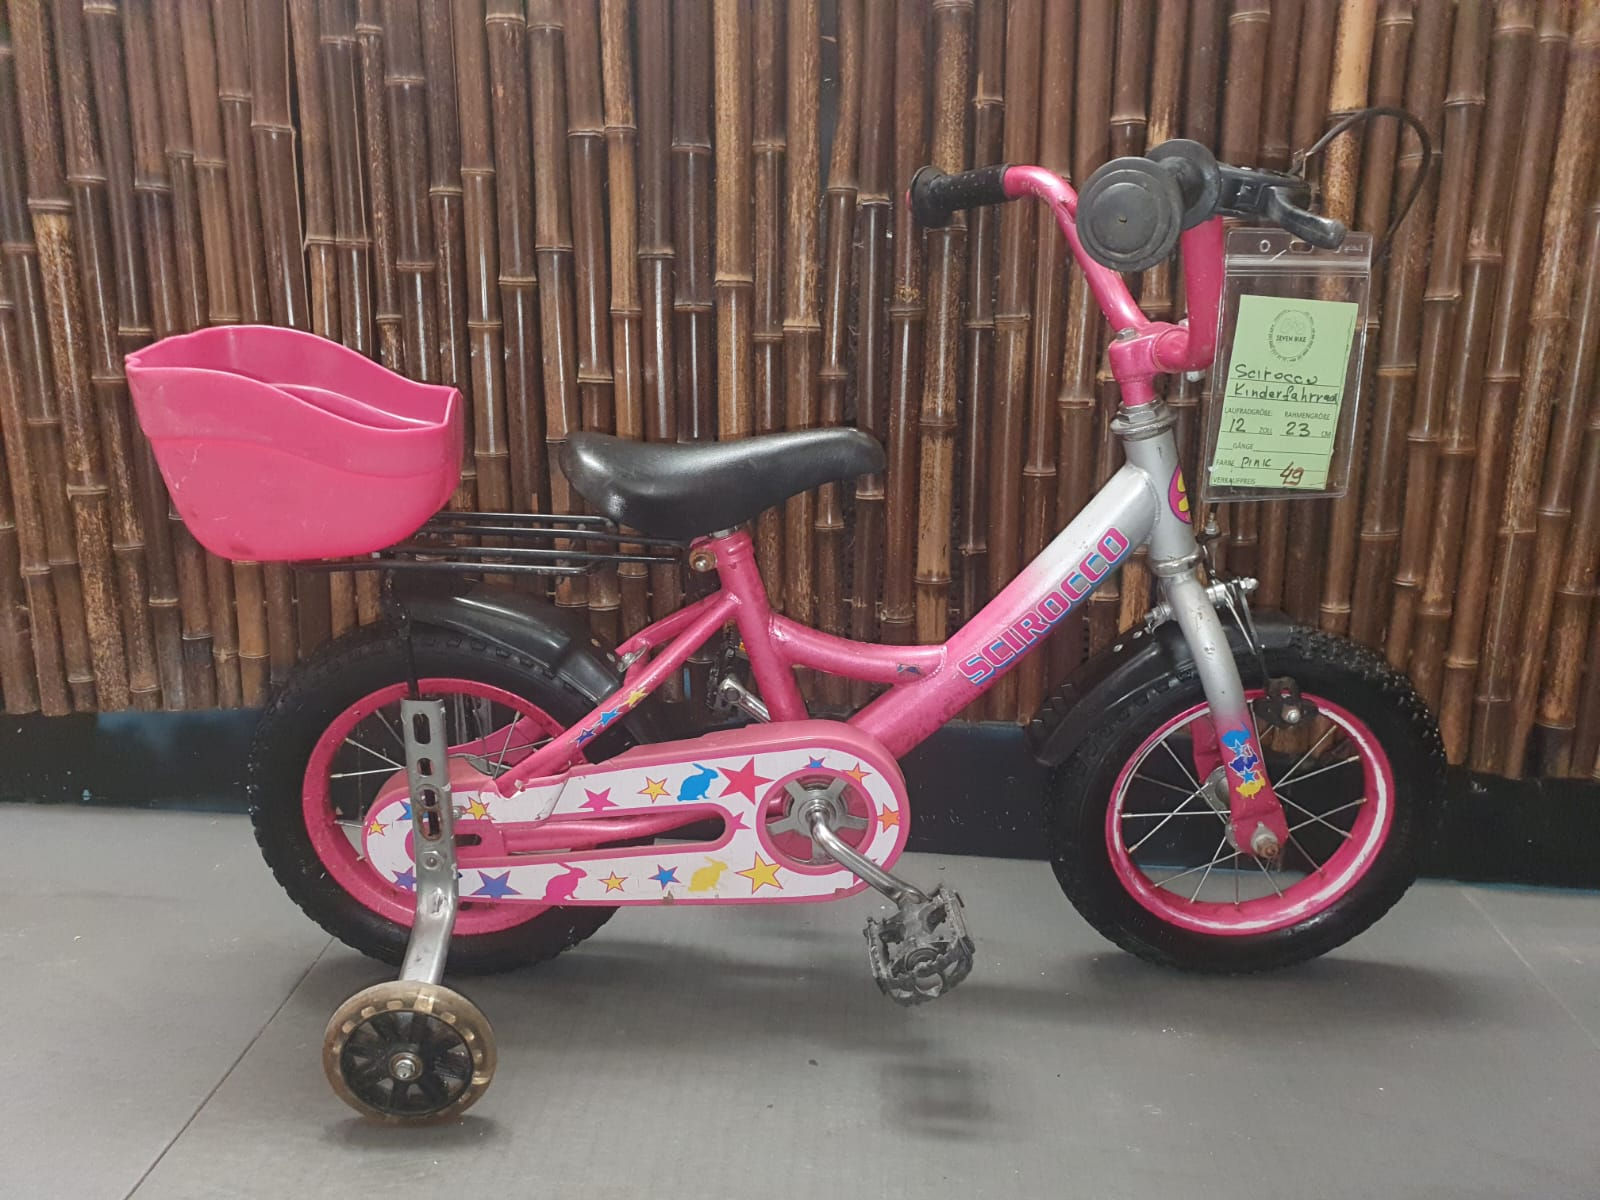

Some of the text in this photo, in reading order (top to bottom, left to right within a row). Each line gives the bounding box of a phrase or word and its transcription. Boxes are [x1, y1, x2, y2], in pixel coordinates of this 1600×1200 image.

[1294, 335, 1307, 343] BIKE
[1229, 418, 1246, 433] 12
[1286, 421, 1311, 437] 23
[1280, 461, 1305, 486] 49
[957, 527, 1132, 686] SCIROCCO
